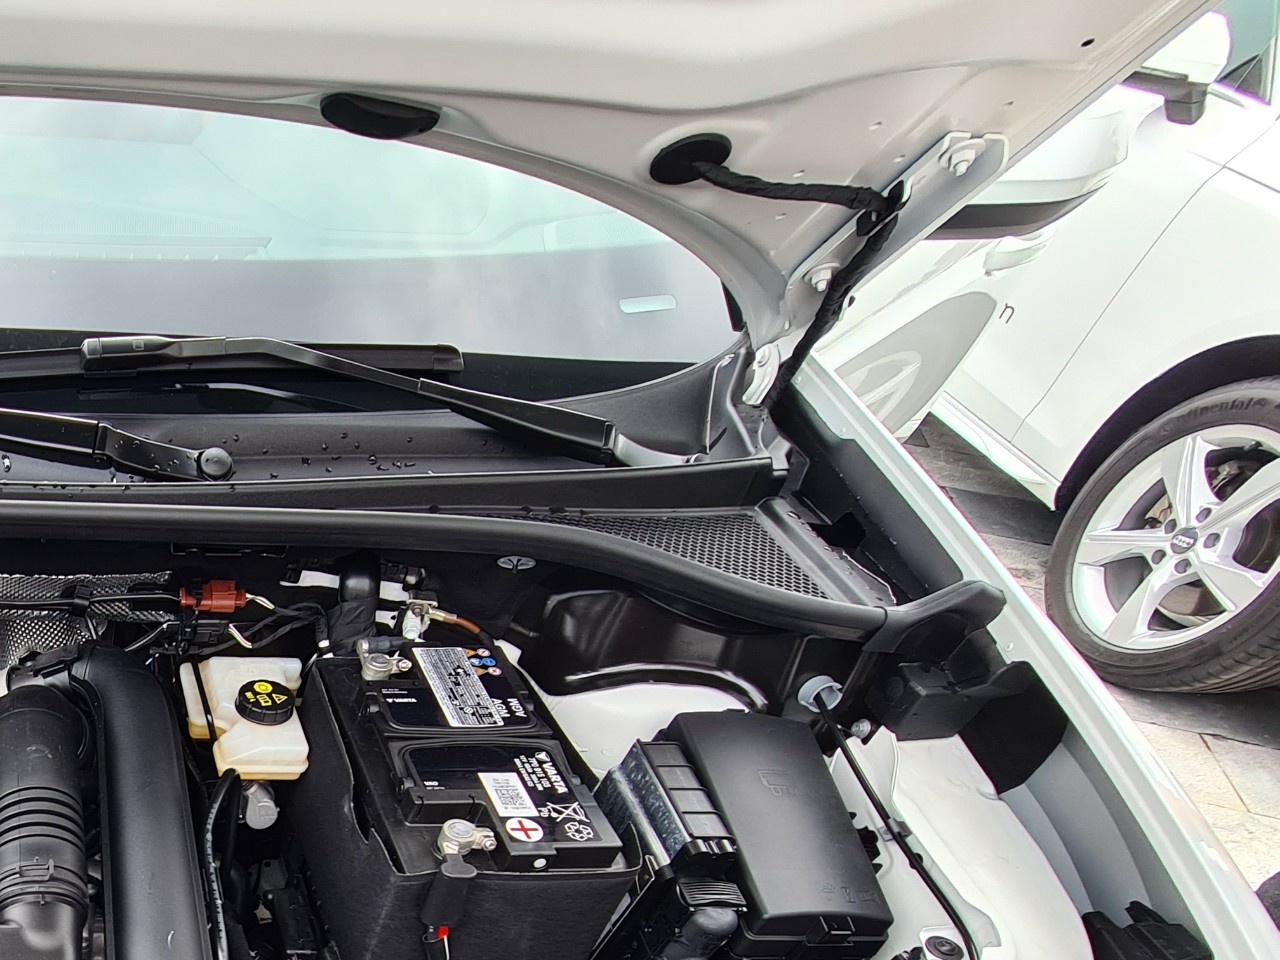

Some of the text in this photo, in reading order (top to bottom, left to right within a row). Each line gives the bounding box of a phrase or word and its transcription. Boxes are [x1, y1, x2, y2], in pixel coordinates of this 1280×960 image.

[492, 698, 510, 718] AGM
[507, 698, 527, 718] AGM
[542, 761, 568, 794] VARTA
[538, 807, 550, 818] Pb
